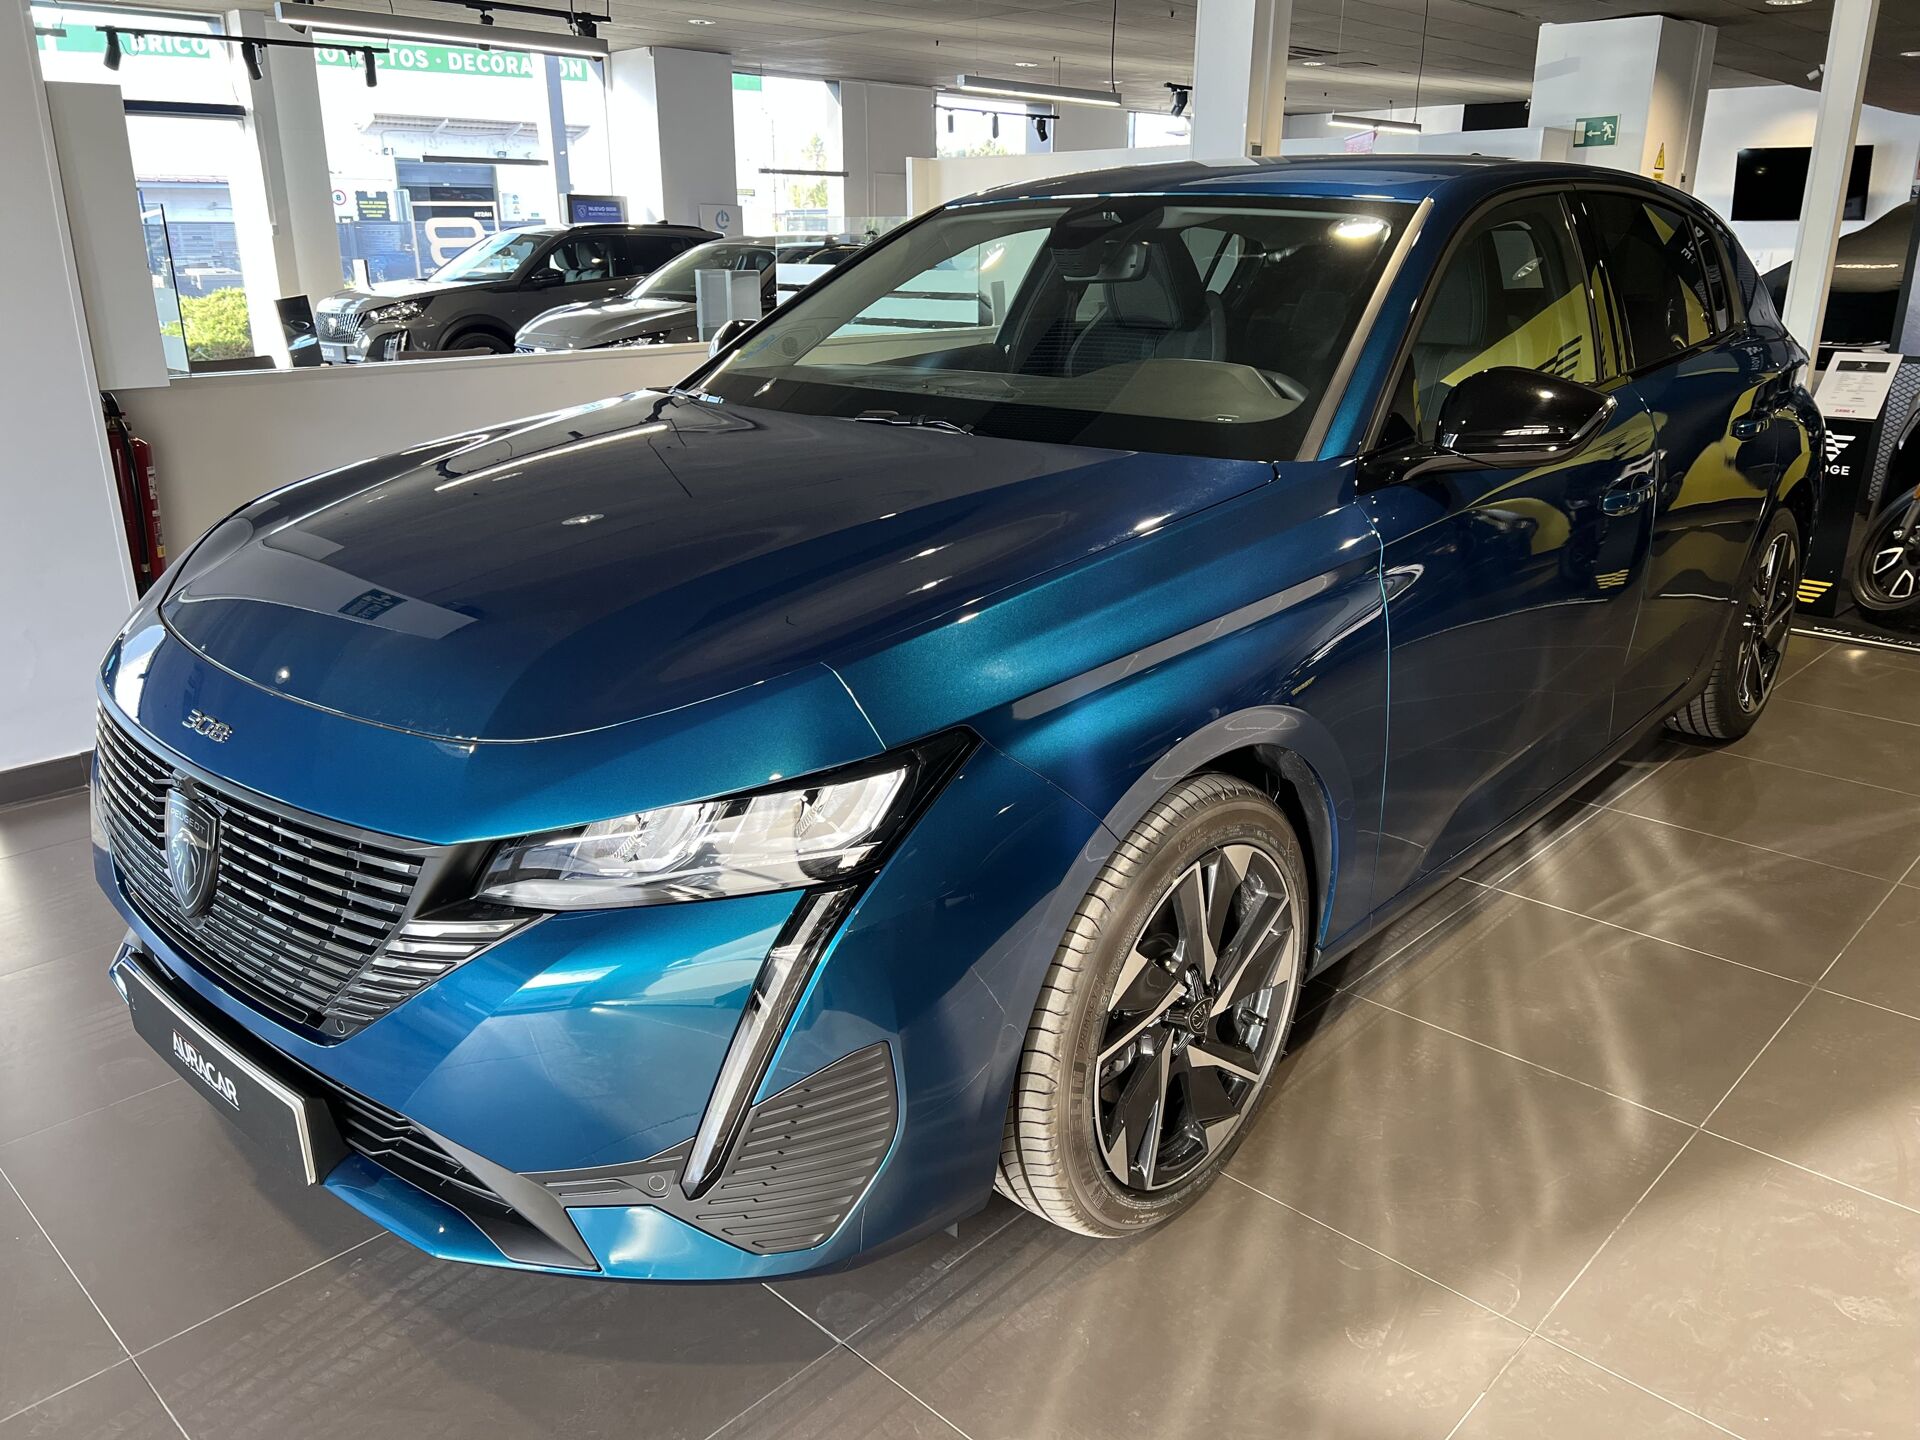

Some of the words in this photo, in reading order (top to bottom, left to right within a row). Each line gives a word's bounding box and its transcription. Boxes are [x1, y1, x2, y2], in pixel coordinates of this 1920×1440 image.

[129, 34, 208, 54] BRICO
[1824, 464, 1851, 476] GE
[182, 708, 233, 743] 308
[169, 807, 206, 835] PEUGEOT
[1078, 990, 1098, 1050] PRIMACY
[172, 1031, 240, 1107] AURACAR
